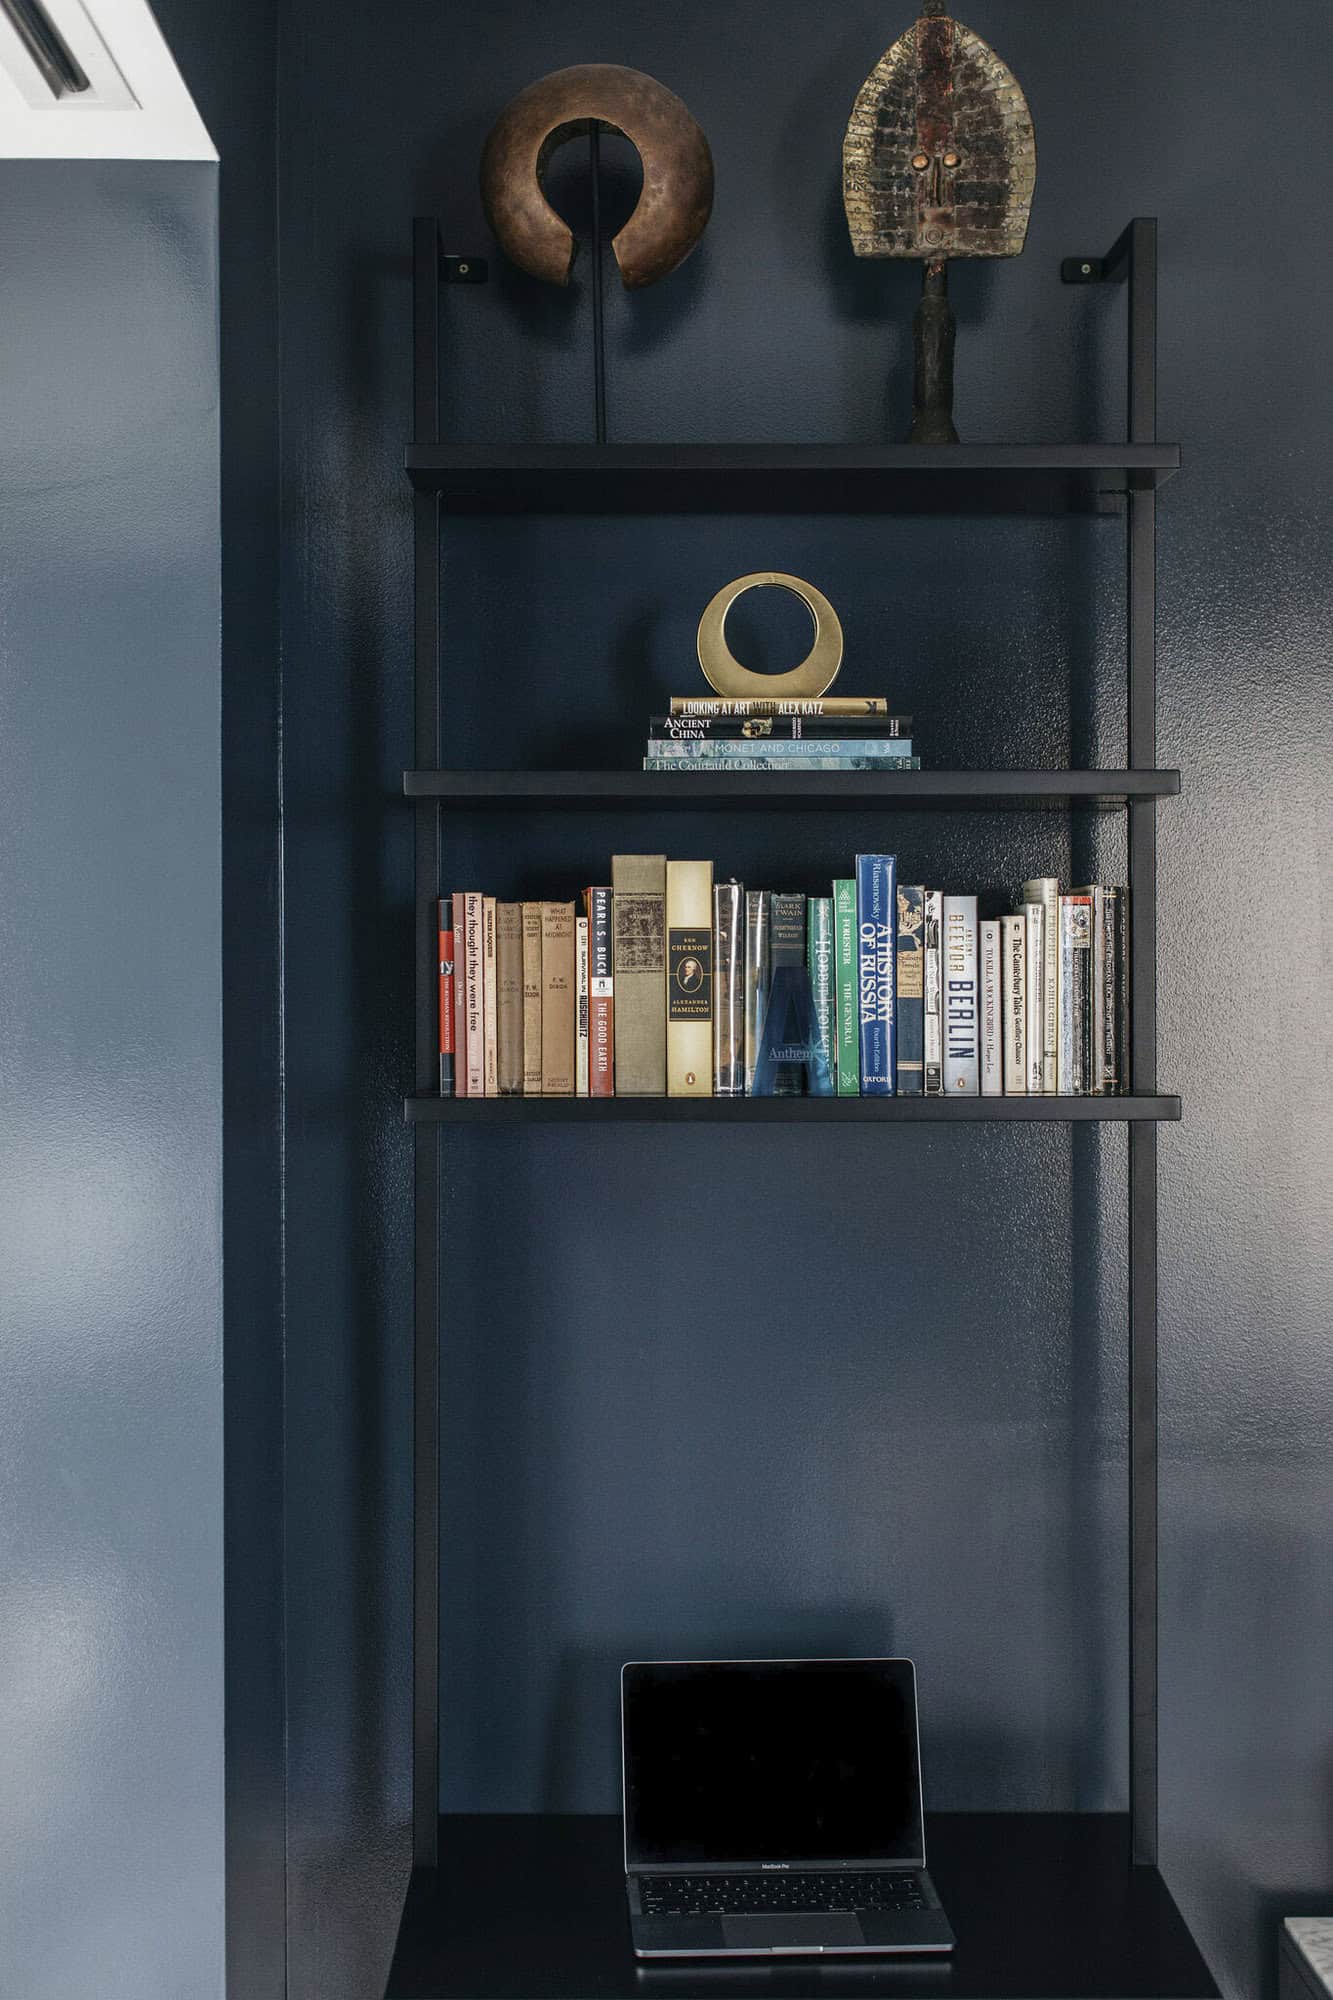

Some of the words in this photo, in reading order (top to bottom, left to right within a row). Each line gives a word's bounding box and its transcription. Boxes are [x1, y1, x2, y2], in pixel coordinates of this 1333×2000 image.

[683, 701, 719, 715] LOOKING
[721, 701, 733, 715] AT
[734, 701, 750, 715] ART
[752, 701, 777, 714] WITH
[778, 701, 800, 715] ALEX
[802, 701, 824, 715] KATZ
[664, 717, 711, 729] ANCIENT
[670, 728, 705, 739] CHINA
[715, 743, 754, 753] MONET
[757, 743, 785, 753] AND
[787, 743, 840, 753] CHICAGO
[656, 759, 676, 771] The
[679, 759, 733, 771] Courtauld
[871, 863, 881, 920] Riasanovsky
[1048, 889, 1056, 909] THE
[467, 896, 478, 917] they
[597, 892, 606, 925] PEARL
[454, 923, 464, 944] Kant
[467, 920, 479, 957] thought
[597, 931, 606, 941] S.
[860, 922, 876, 949] OF
[877, 922, 893, 937] A
[1048, 915, 1056, 966] PROPHET
[843, 918, 851, 965] FORESTER
[949, 914, 964, 972] BEEVOR
[1013, 938, 1022, 953] The
[597, 947, 606, 975] BUCK
[986, 949, 993, 959] TO
[467, 960, 479, 981] they
[815, 941, 831, 995] HOBBIT
[1012, 953, 1022, 995] Canterbury
[843, 982, 851, 1000] THE
[860, 954, 876, 1025] RUSSIA
[877, 942, 893, 1025] HISTORY
[579, 995, 587, 1038] AUSCHWITZ
[598, 1002, 607, 1017] THE
[986, 985, 994, 1037] MOCKINGBIRD
[1013, 996, 1023, 1016] Tales
[470, 1012, 479, 1031] free
[844, 1003, 853, 1047] GENERAL
[949, 981, 975, 1058] BERLIN
[598, 1021, 607, 1043] GOOD
[598, 1047, 607, 1072] EARTH
